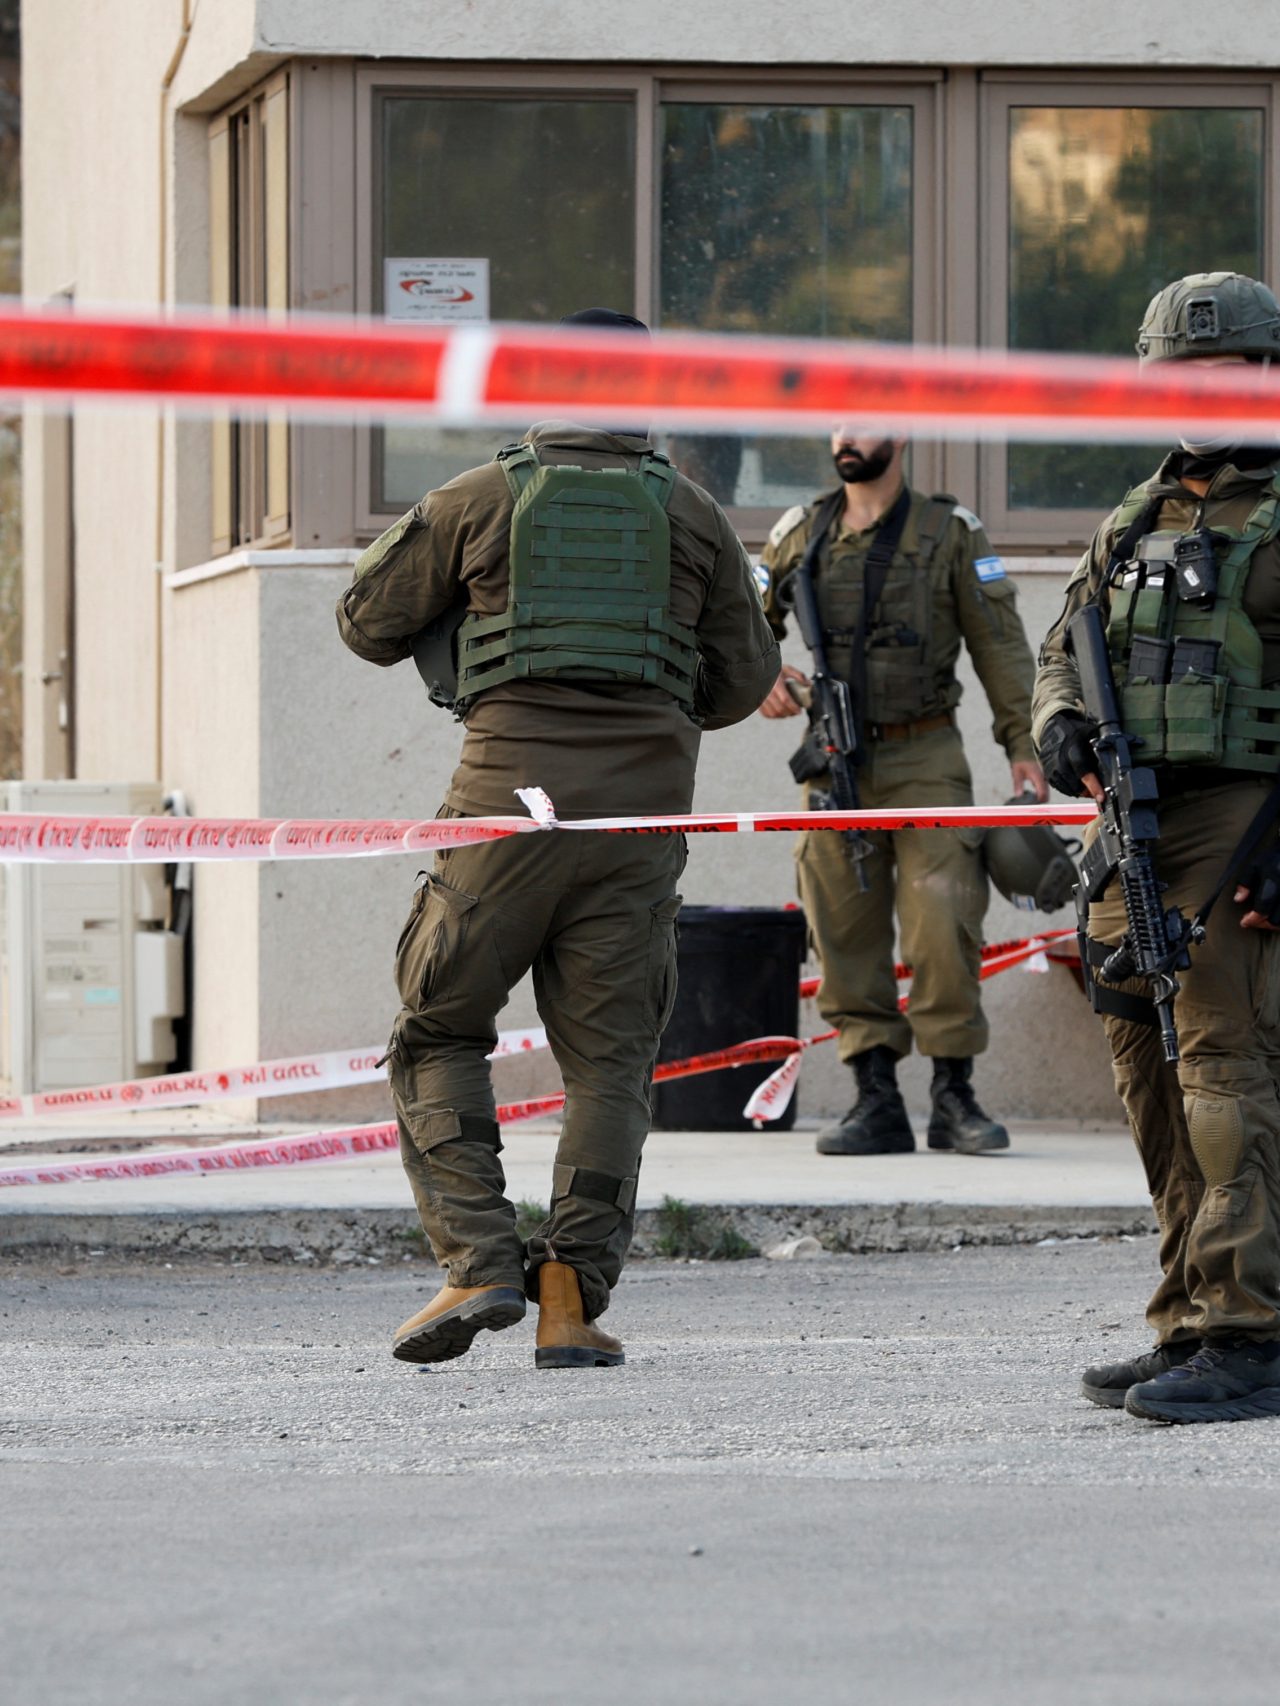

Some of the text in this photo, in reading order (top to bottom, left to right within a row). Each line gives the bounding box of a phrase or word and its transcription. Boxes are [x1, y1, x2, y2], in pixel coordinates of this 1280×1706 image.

[44, 1062, 321, 1106] משטרת ישראל אין מעבר
